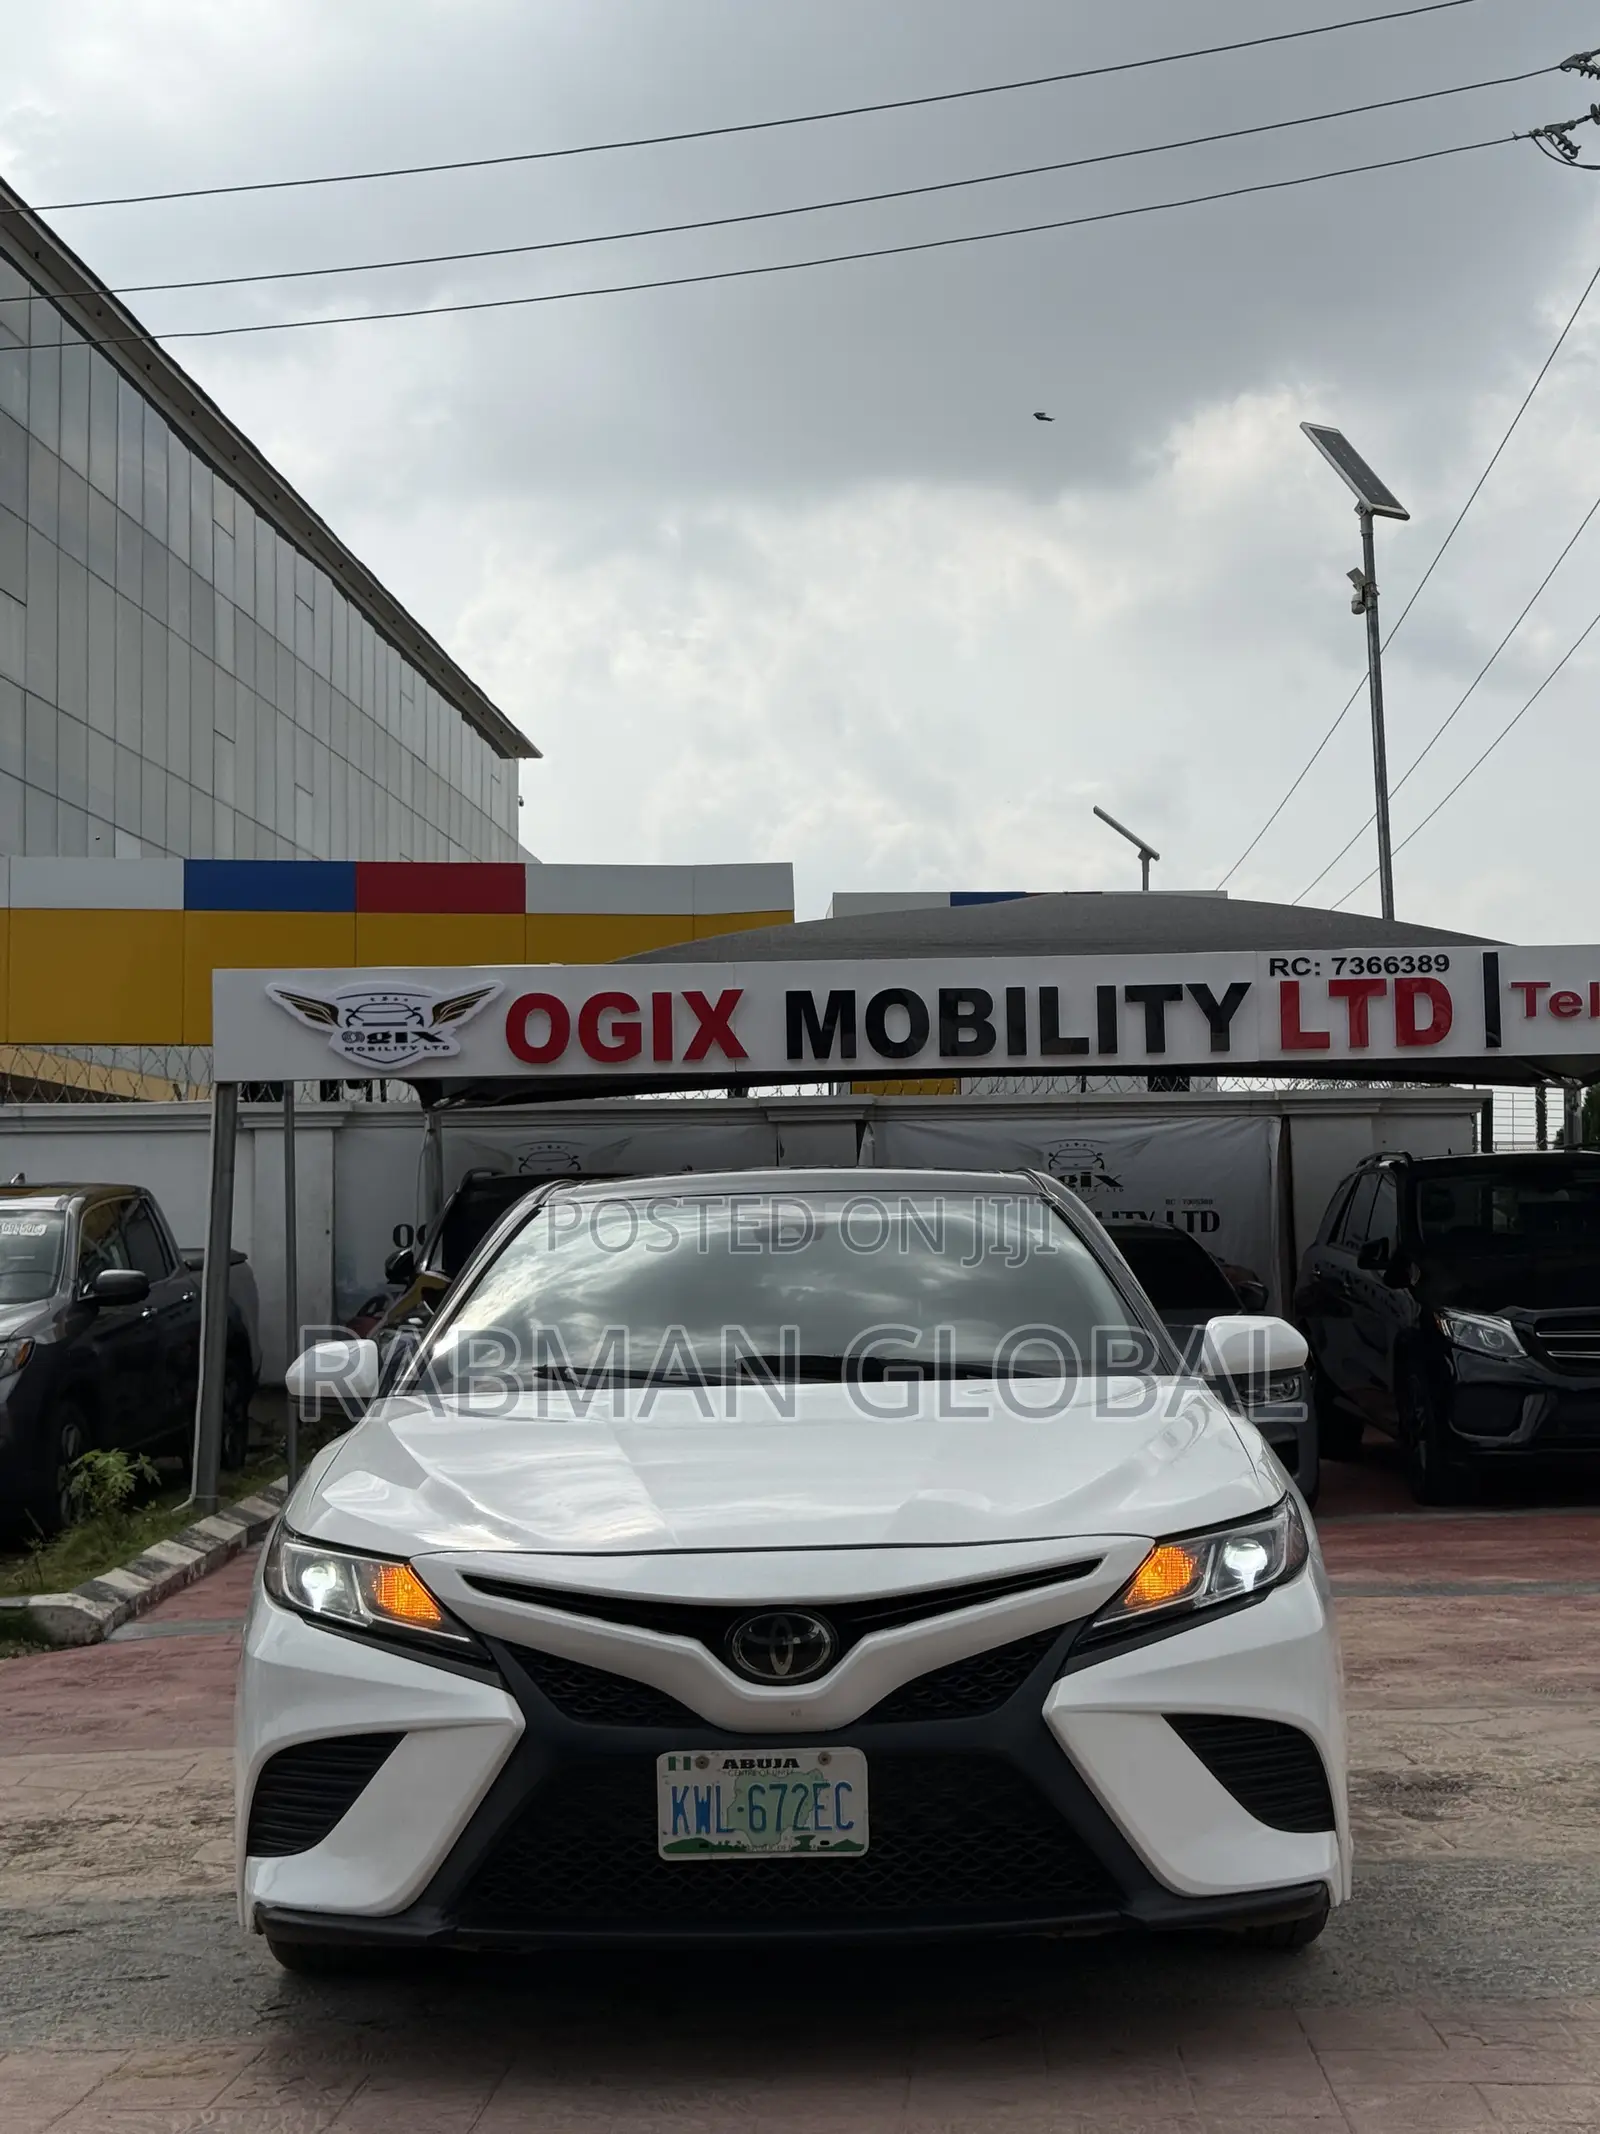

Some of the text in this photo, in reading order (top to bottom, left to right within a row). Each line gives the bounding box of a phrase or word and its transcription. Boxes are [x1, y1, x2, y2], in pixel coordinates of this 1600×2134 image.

[1268, 953, 1451, 977] RC: 7366389
[1509, 981, 1600, 1019] Tel
[504, 976, 1454, 1065] OGIX MOBILITY LTD
[722, 1757, 801, 1770] ABUJA
